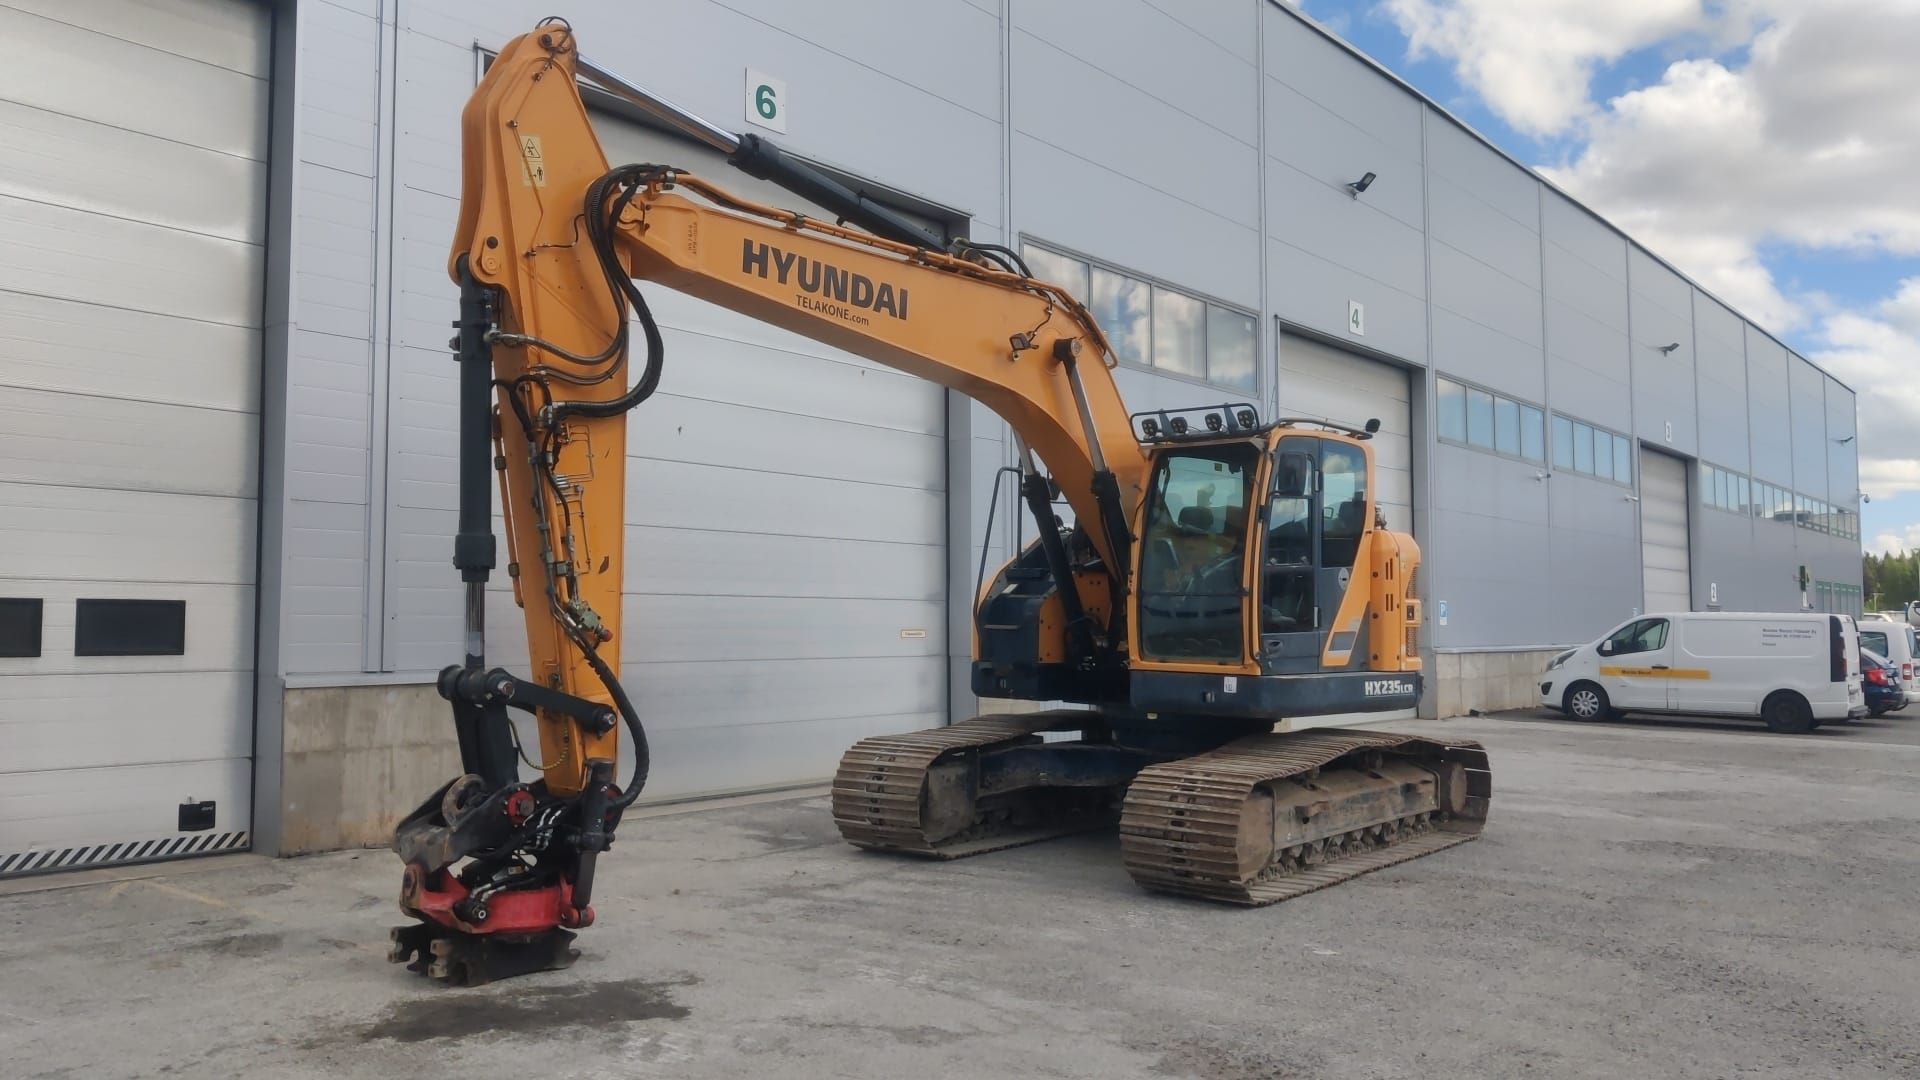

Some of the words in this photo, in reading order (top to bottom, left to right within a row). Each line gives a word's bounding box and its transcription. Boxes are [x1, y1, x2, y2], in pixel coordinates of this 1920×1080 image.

[756, 85, 776, 119] 6
[742, 238, 908, 320] HYUNDAI
[796, 294, 869, 326] TELAKONE.com
[1352, 308, 1359, 328] 4
